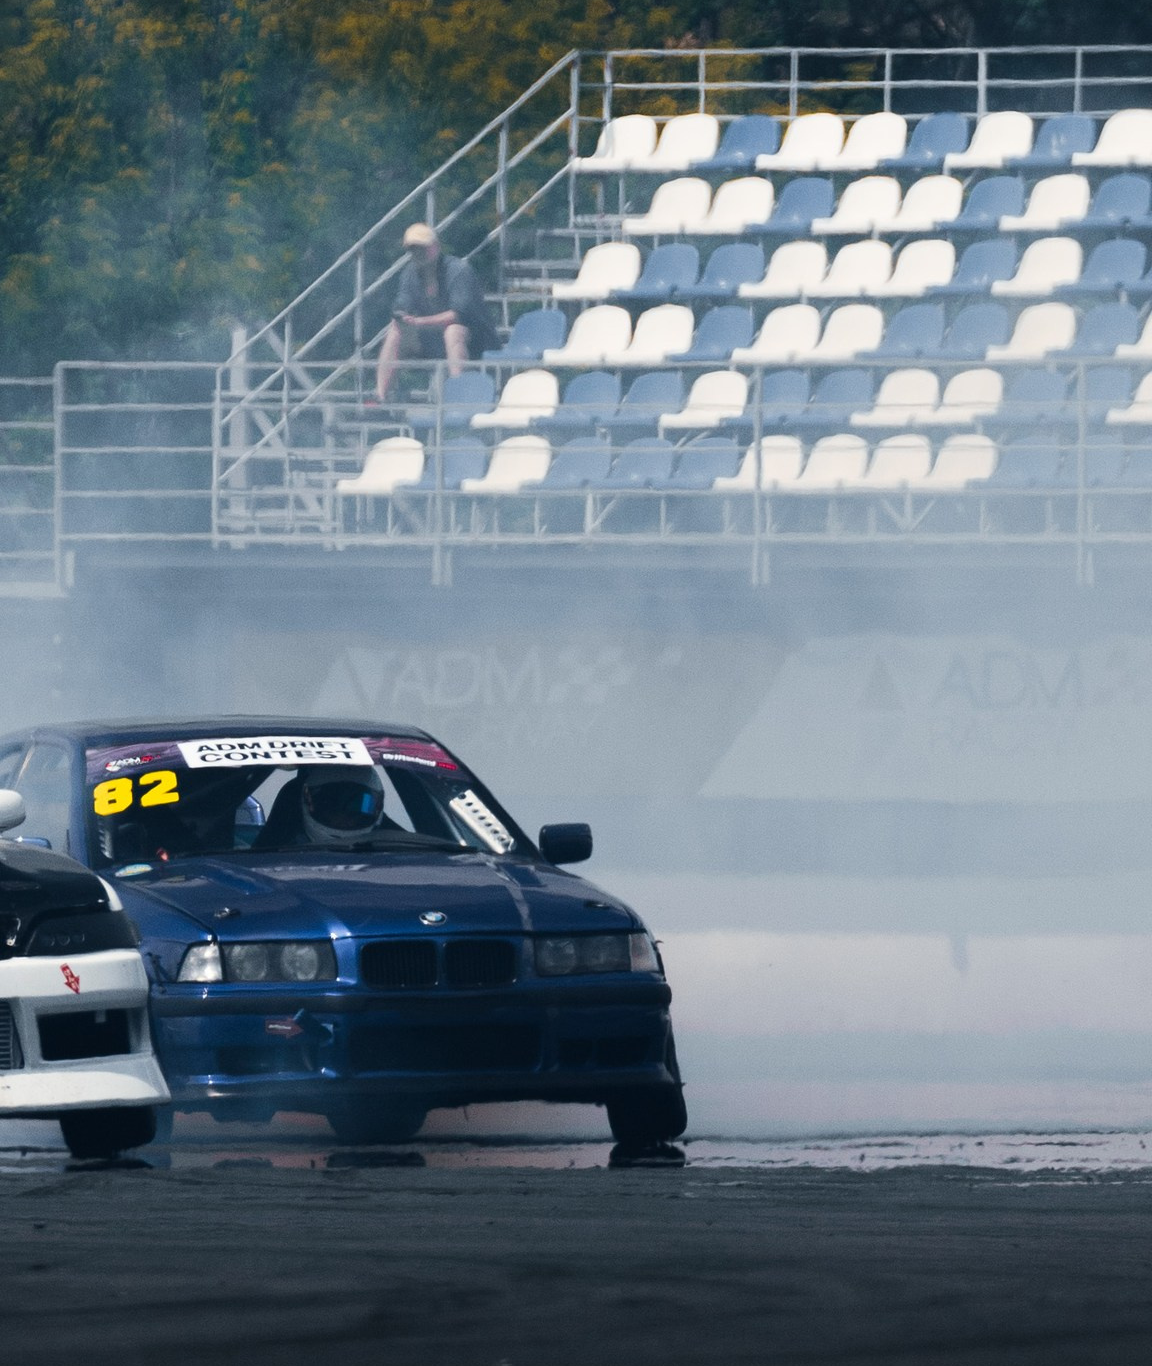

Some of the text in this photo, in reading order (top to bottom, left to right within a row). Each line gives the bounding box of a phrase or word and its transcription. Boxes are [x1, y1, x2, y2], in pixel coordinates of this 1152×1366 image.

[197, 740, 351, 753] ADM DRIFT
[199, 749, 356, 763] CONTEST
[93, 770, 180, 816] 82
